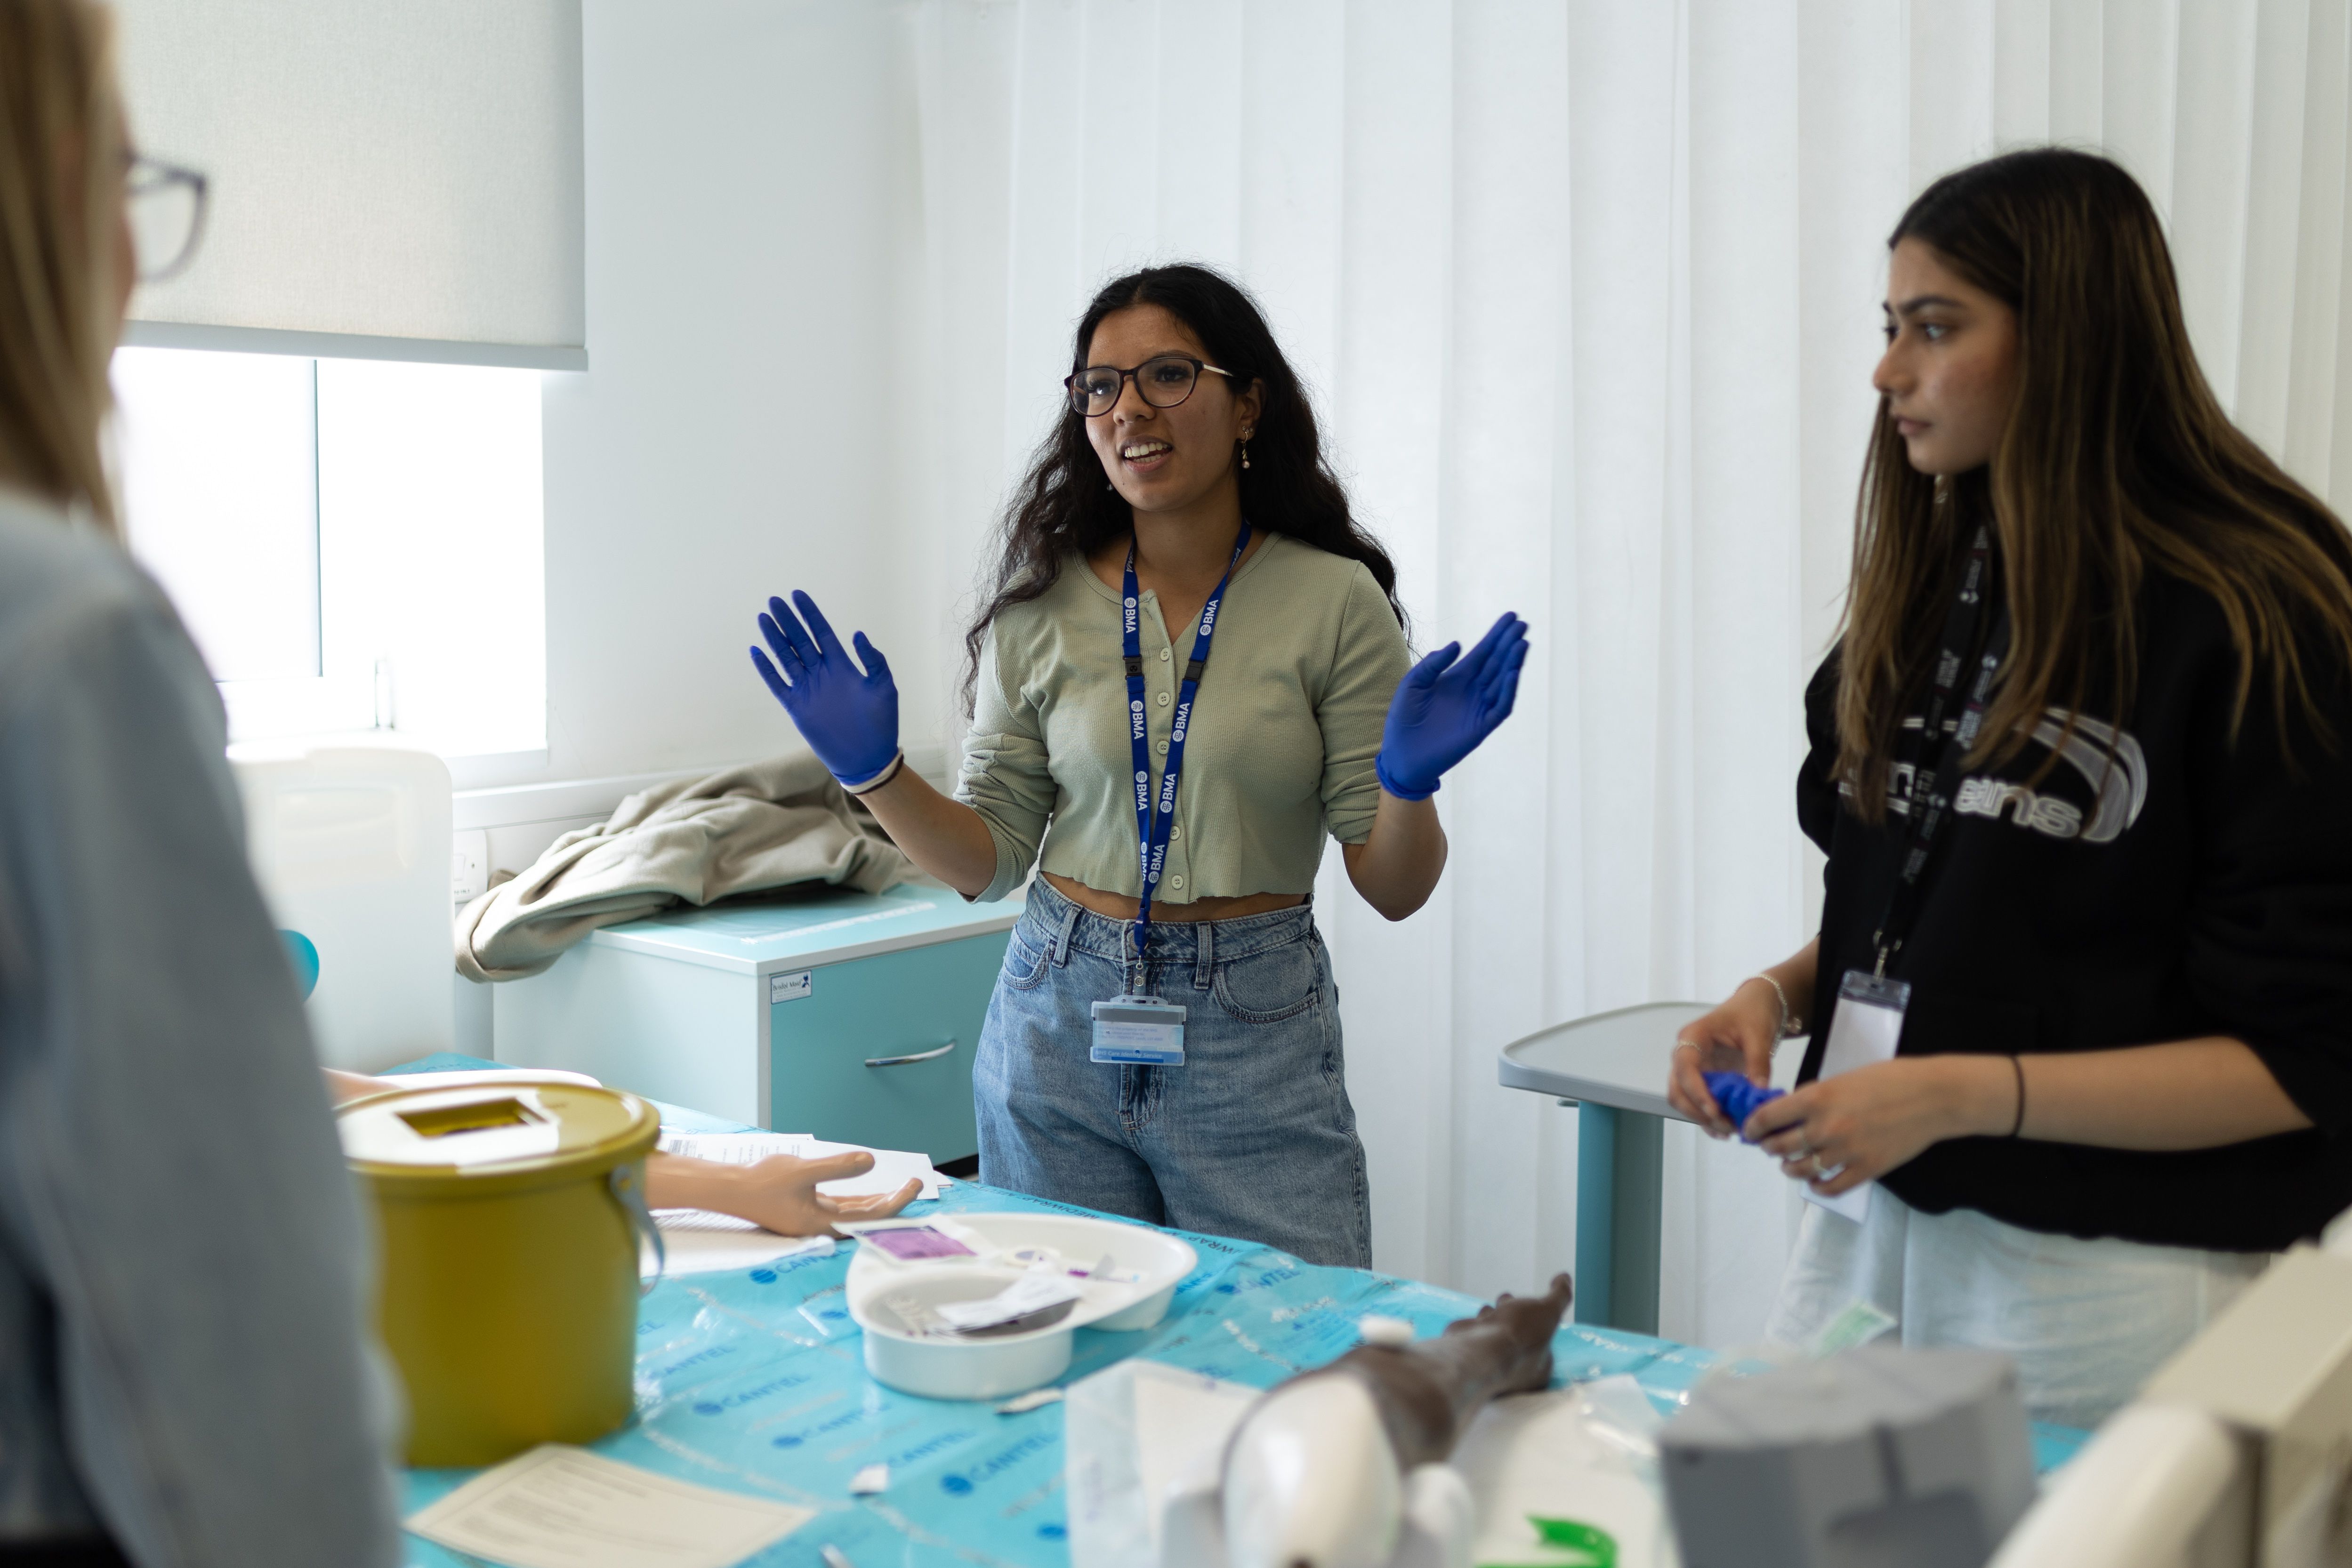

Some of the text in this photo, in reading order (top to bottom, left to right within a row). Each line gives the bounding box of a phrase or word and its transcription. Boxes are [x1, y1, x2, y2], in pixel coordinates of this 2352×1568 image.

[1125, 609, 1136, 633] BMA
[1203, 599, 1218, 624] BMA
[1132, 713, 1144, 740] BMA
[1175, 703, 1190, 730] BMA
[1136, 784, 1148, 811] BMA
[1162, 773, 1176, 800] BMA
[1151, 844, 1165, 871] BMA
